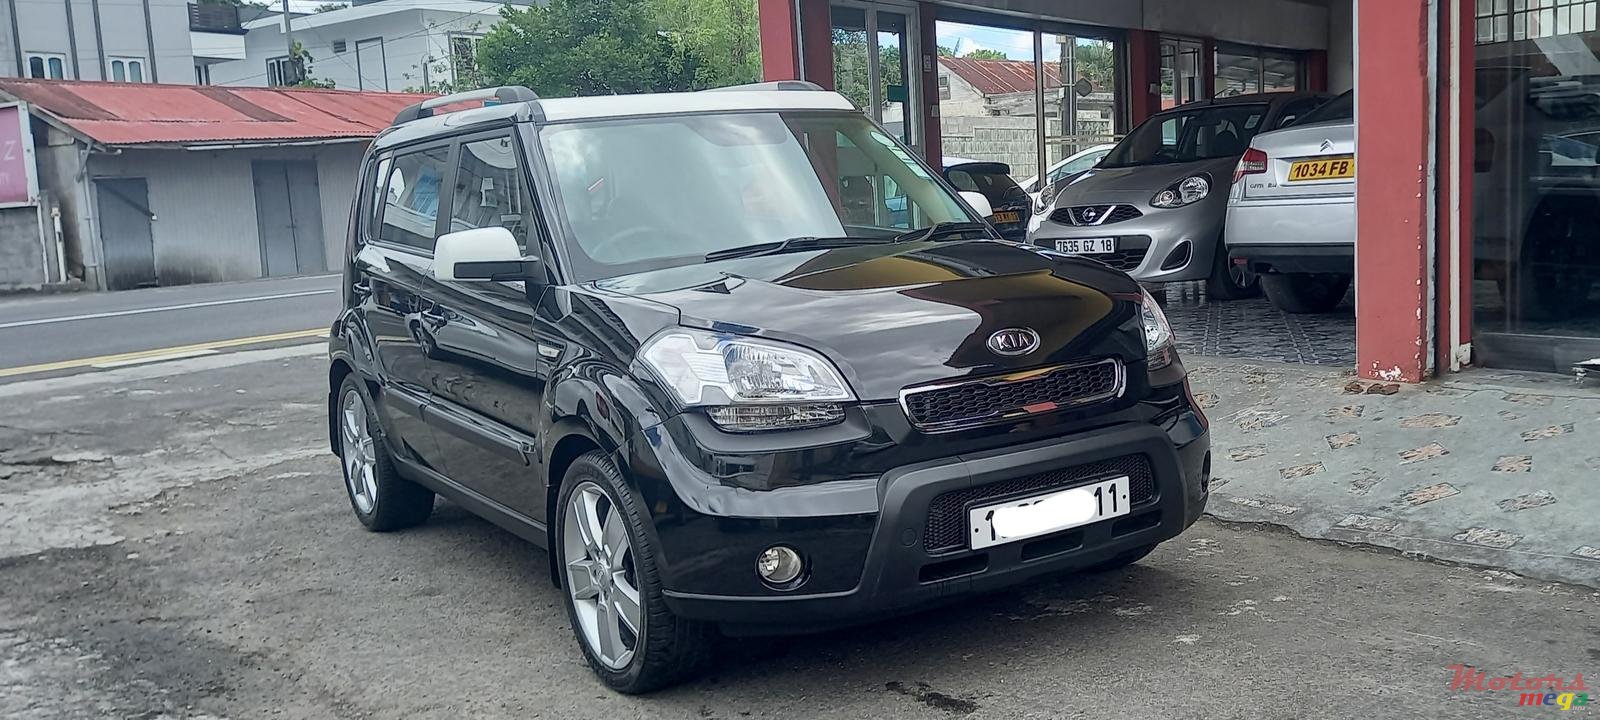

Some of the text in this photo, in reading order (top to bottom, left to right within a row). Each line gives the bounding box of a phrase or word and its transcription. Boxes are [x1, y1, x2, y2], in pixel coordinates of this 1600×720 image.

[1294, 160, 1349, 178] 1034 FB
[1057, 239, 1113, 253] 7635 GZ 18
[994, 332, 1032, 350] KIA
[1094, 483, 1118, 517] 11
